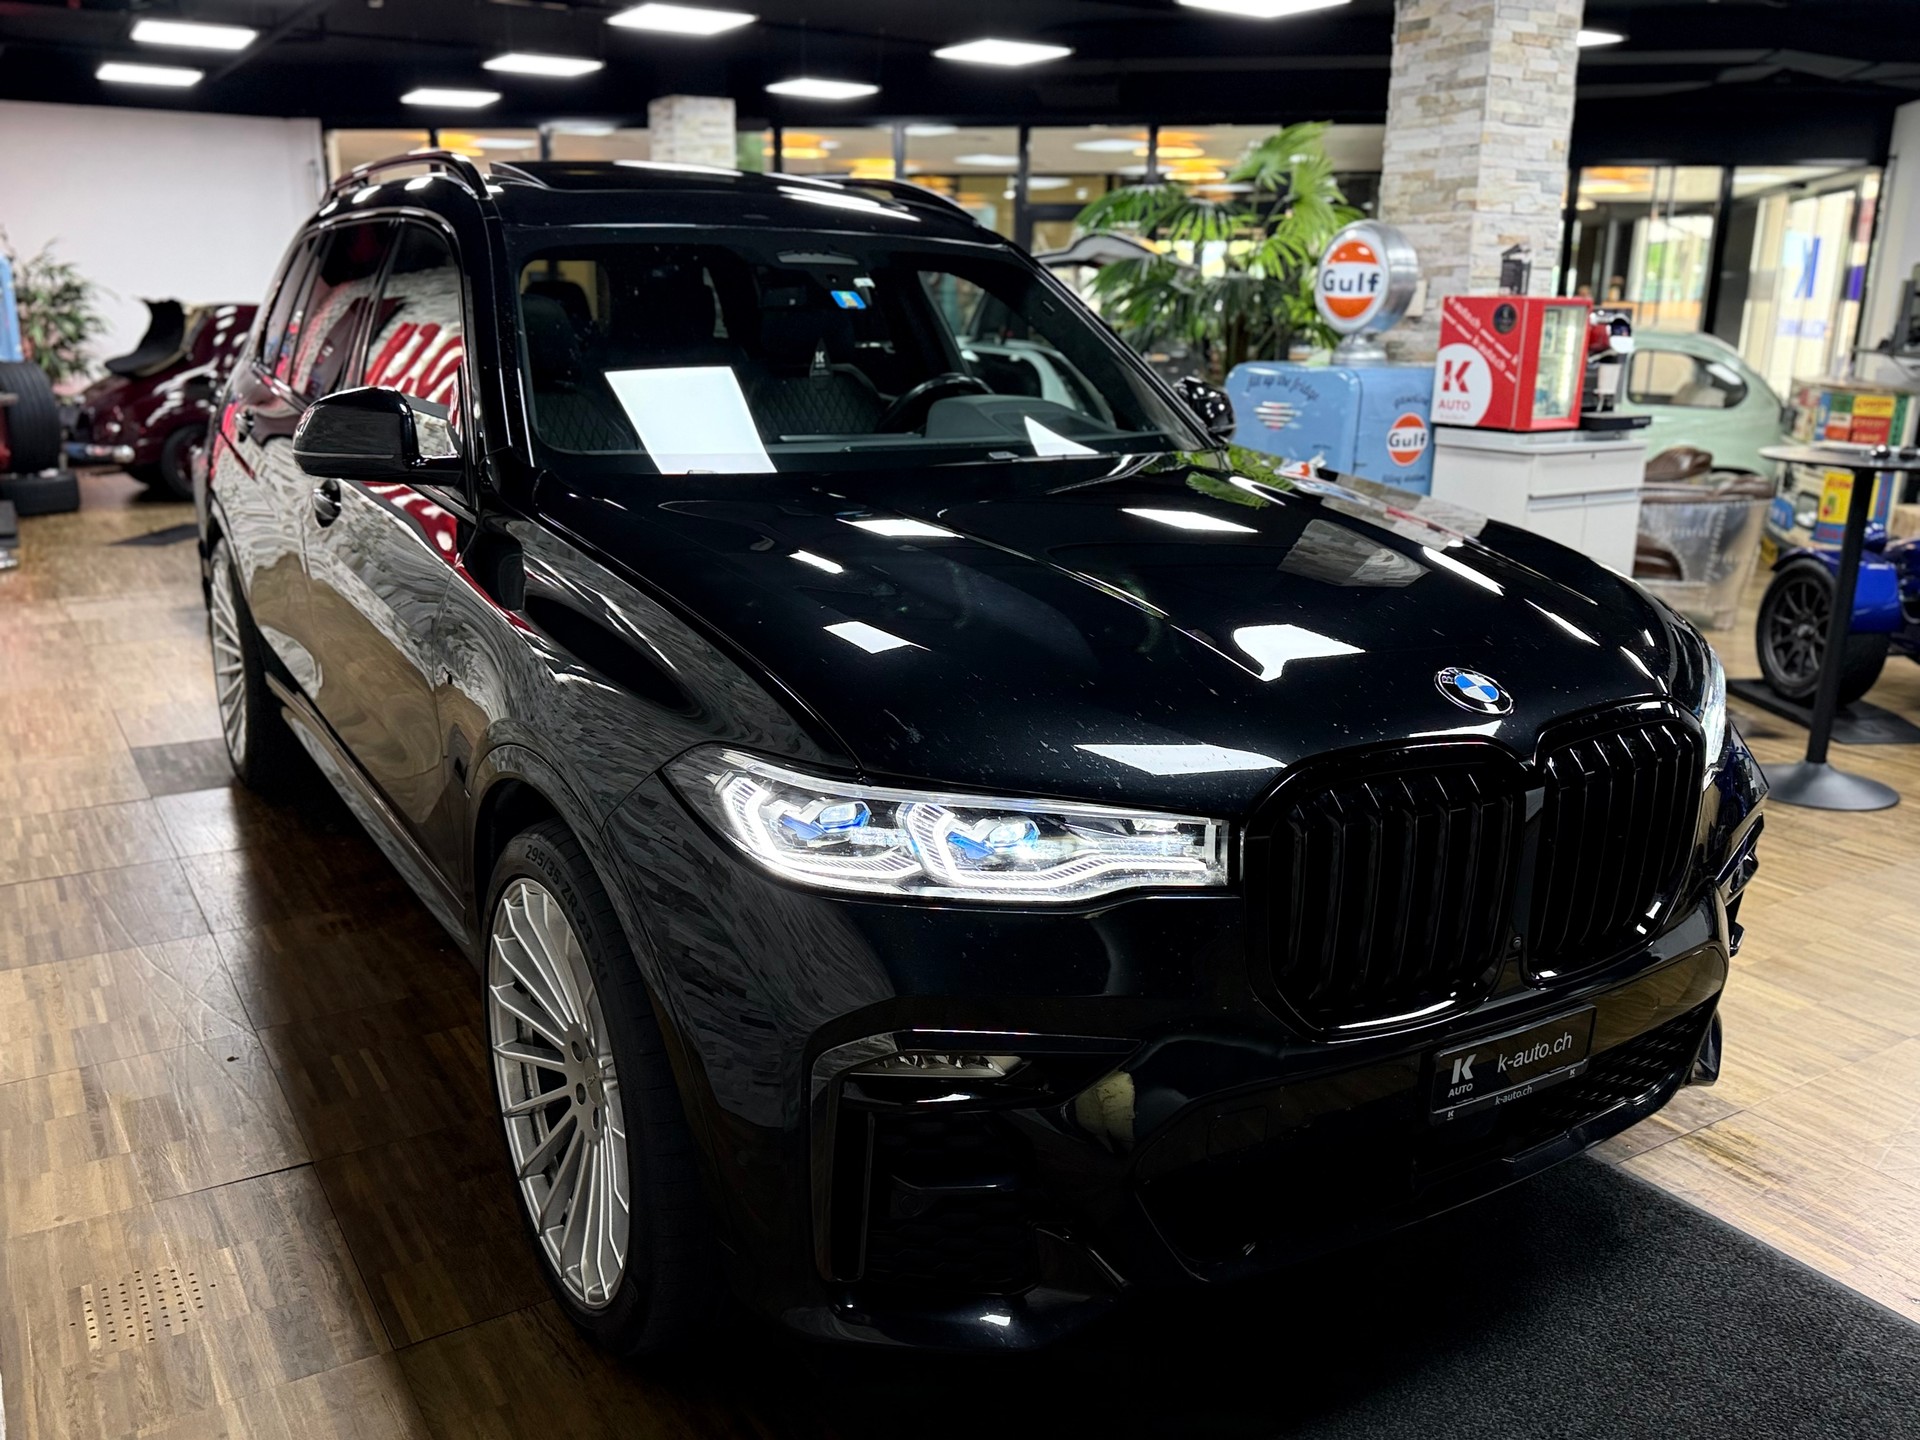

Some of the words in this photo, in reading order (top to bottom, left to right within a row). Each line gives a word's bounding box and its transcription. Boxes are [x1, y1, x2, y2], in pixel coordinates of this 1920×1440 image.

[1322, 268, 1380, 293] Gulf
[1442, 359, 1473, 394] K
[1438, 399, 1472, 412] AUTO
[1388, 432, 1427, 449] Gulf
[525, 844, 562, 885] 295/35
[1451, 1053, 1477, 1085] K
[1497, 1031, 1573, 1074] k-auto.ch
[1447, 1083, 1474, 1099] AUTO
[1494, 1084, 1533, 1106] k-auto.ch
